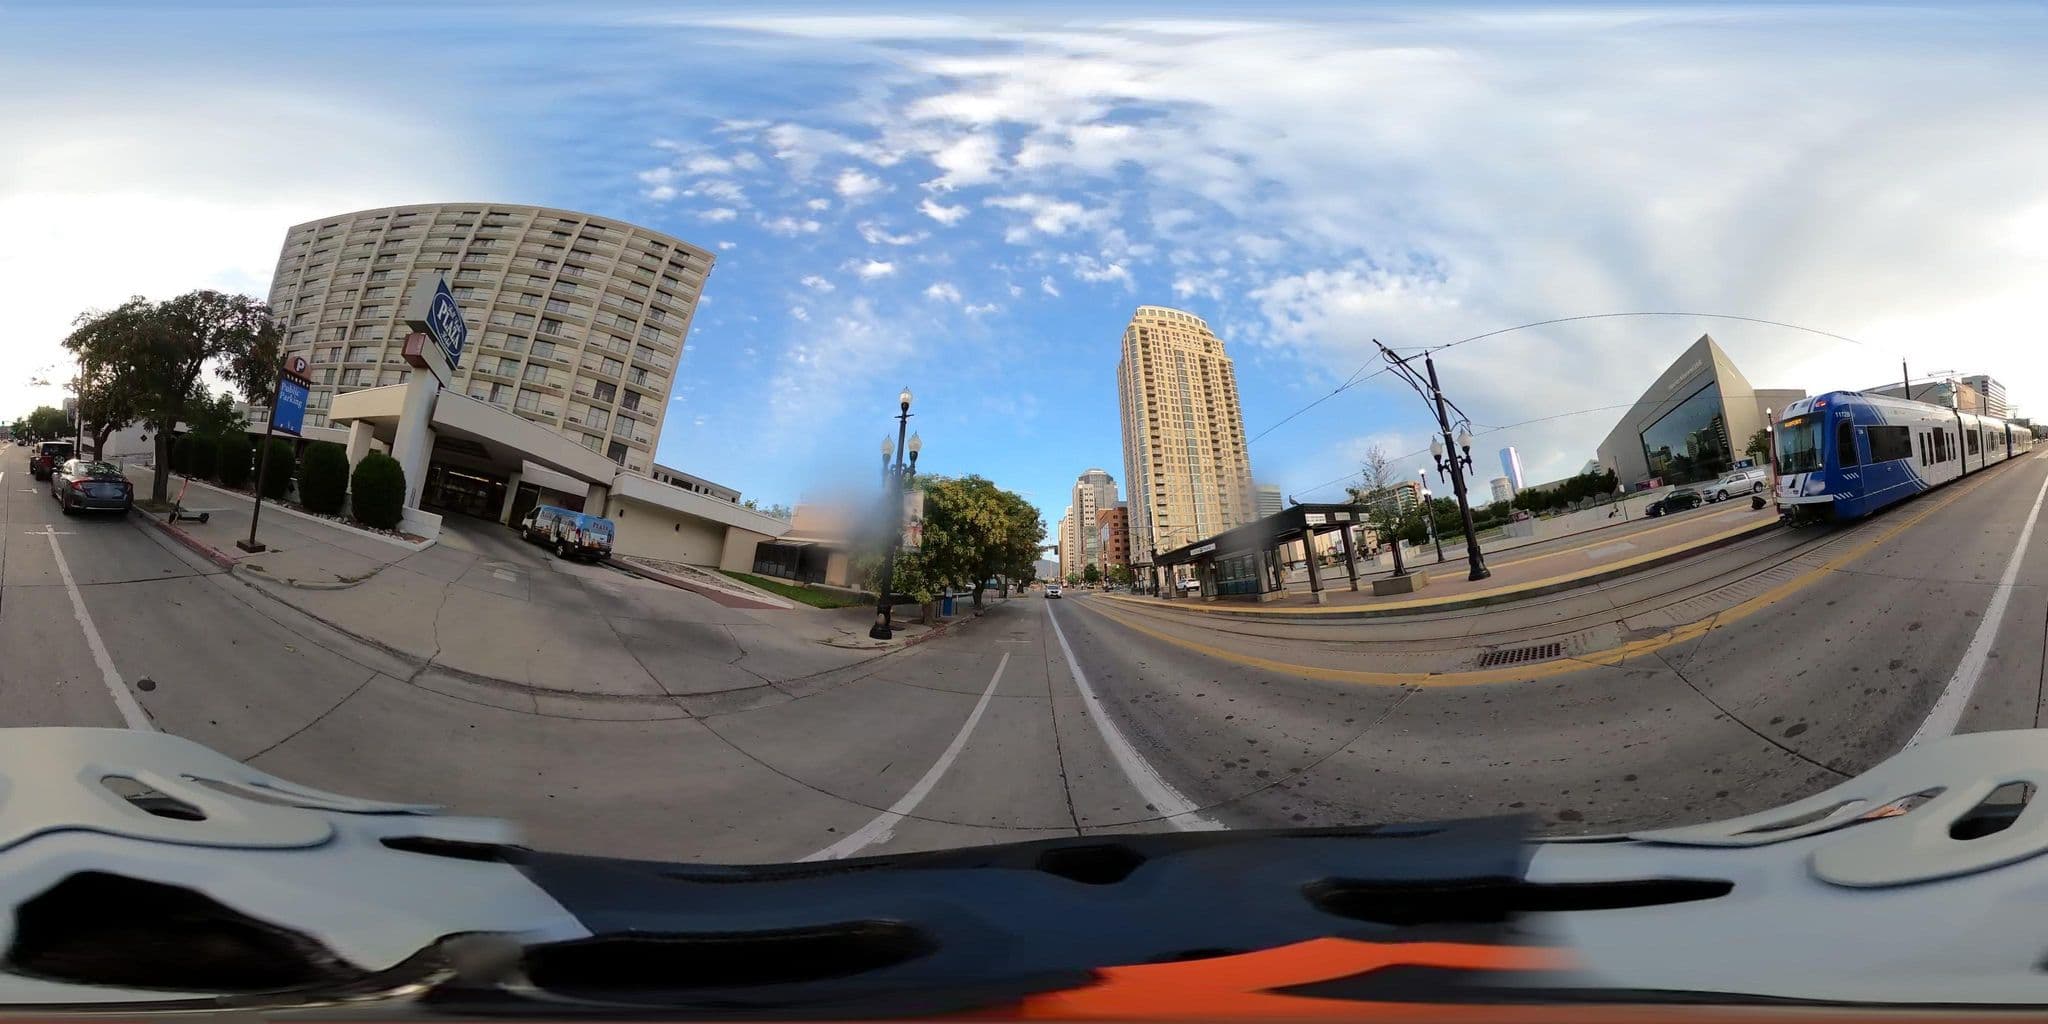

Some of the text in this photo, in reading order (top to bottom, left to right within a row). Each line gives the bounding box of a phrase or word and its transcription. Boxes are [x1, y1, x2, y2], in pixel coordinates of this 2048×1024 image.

[437, 300, 460, 350] PLAZA
[296, 358, 305, 372] P
[281, 382, 301, 397] Public
[280, 391, 303, 409] Parking
